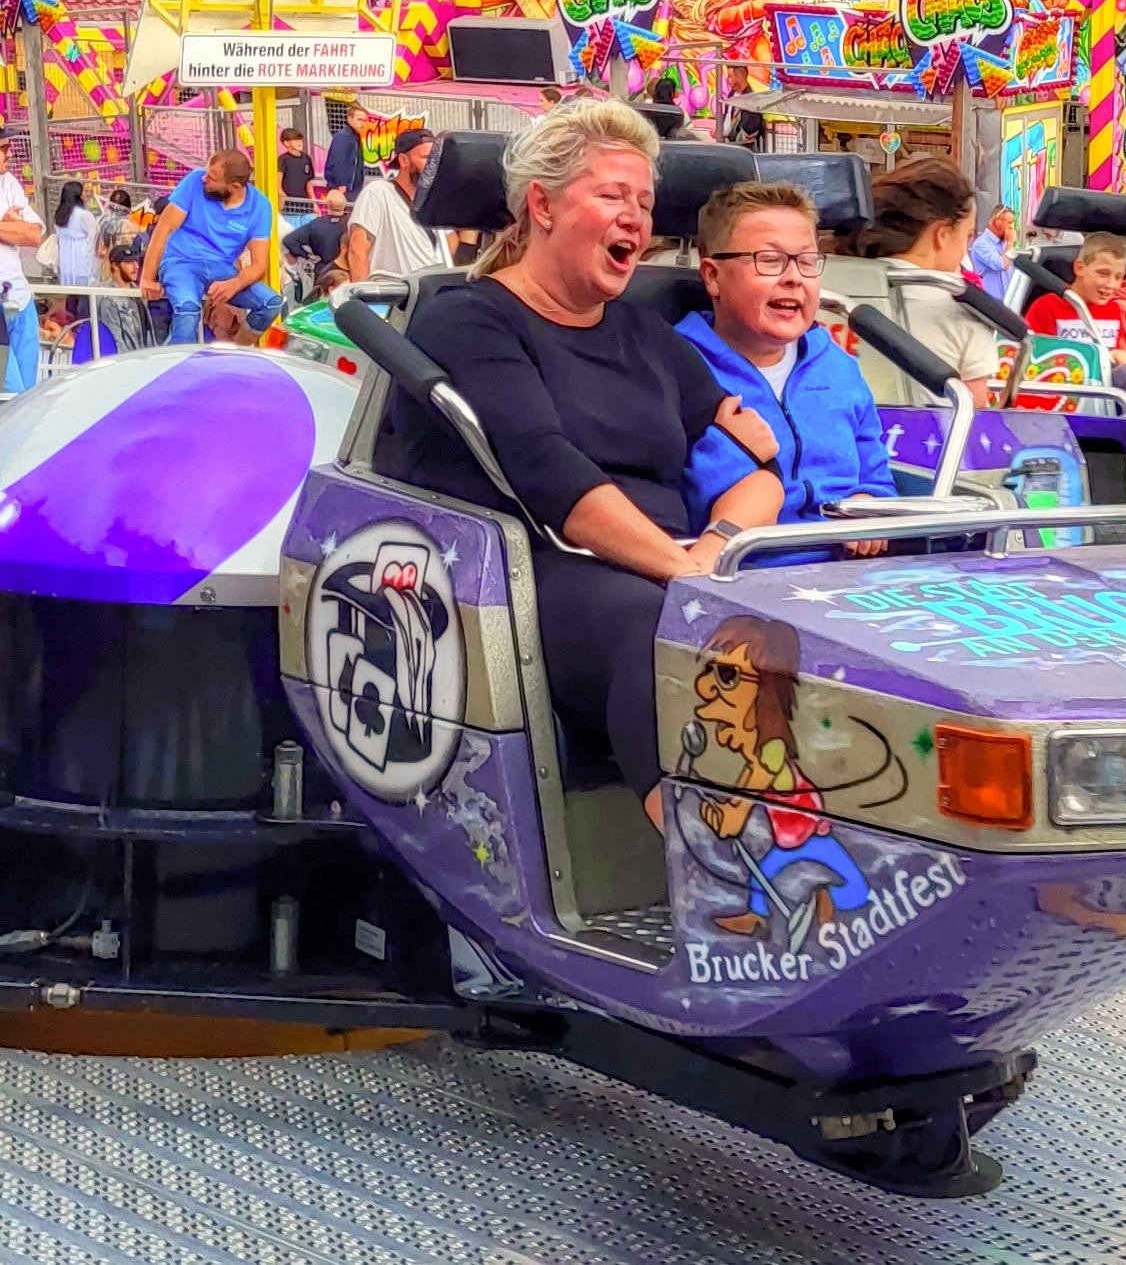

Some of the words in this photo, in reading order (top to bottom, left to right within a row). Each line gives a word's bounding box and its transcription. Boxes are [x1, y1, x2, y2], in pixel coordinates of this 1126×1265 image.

[223, 42, 284, 57] Während
[288, 43, 310, 57] der
[313, 43, 356, 57] FAHRT
[188, 63, 230, 77] hinter
[234, 63, 254, 77] die
[258, 63, 292, 77] ROTE
[296, 63, 385, 77] MARKIERUNG
[845, 588, 930, 611] DIE
[685, 941, 813, 984] Brucker
[818, 854, 966, 971] Stadtfest
